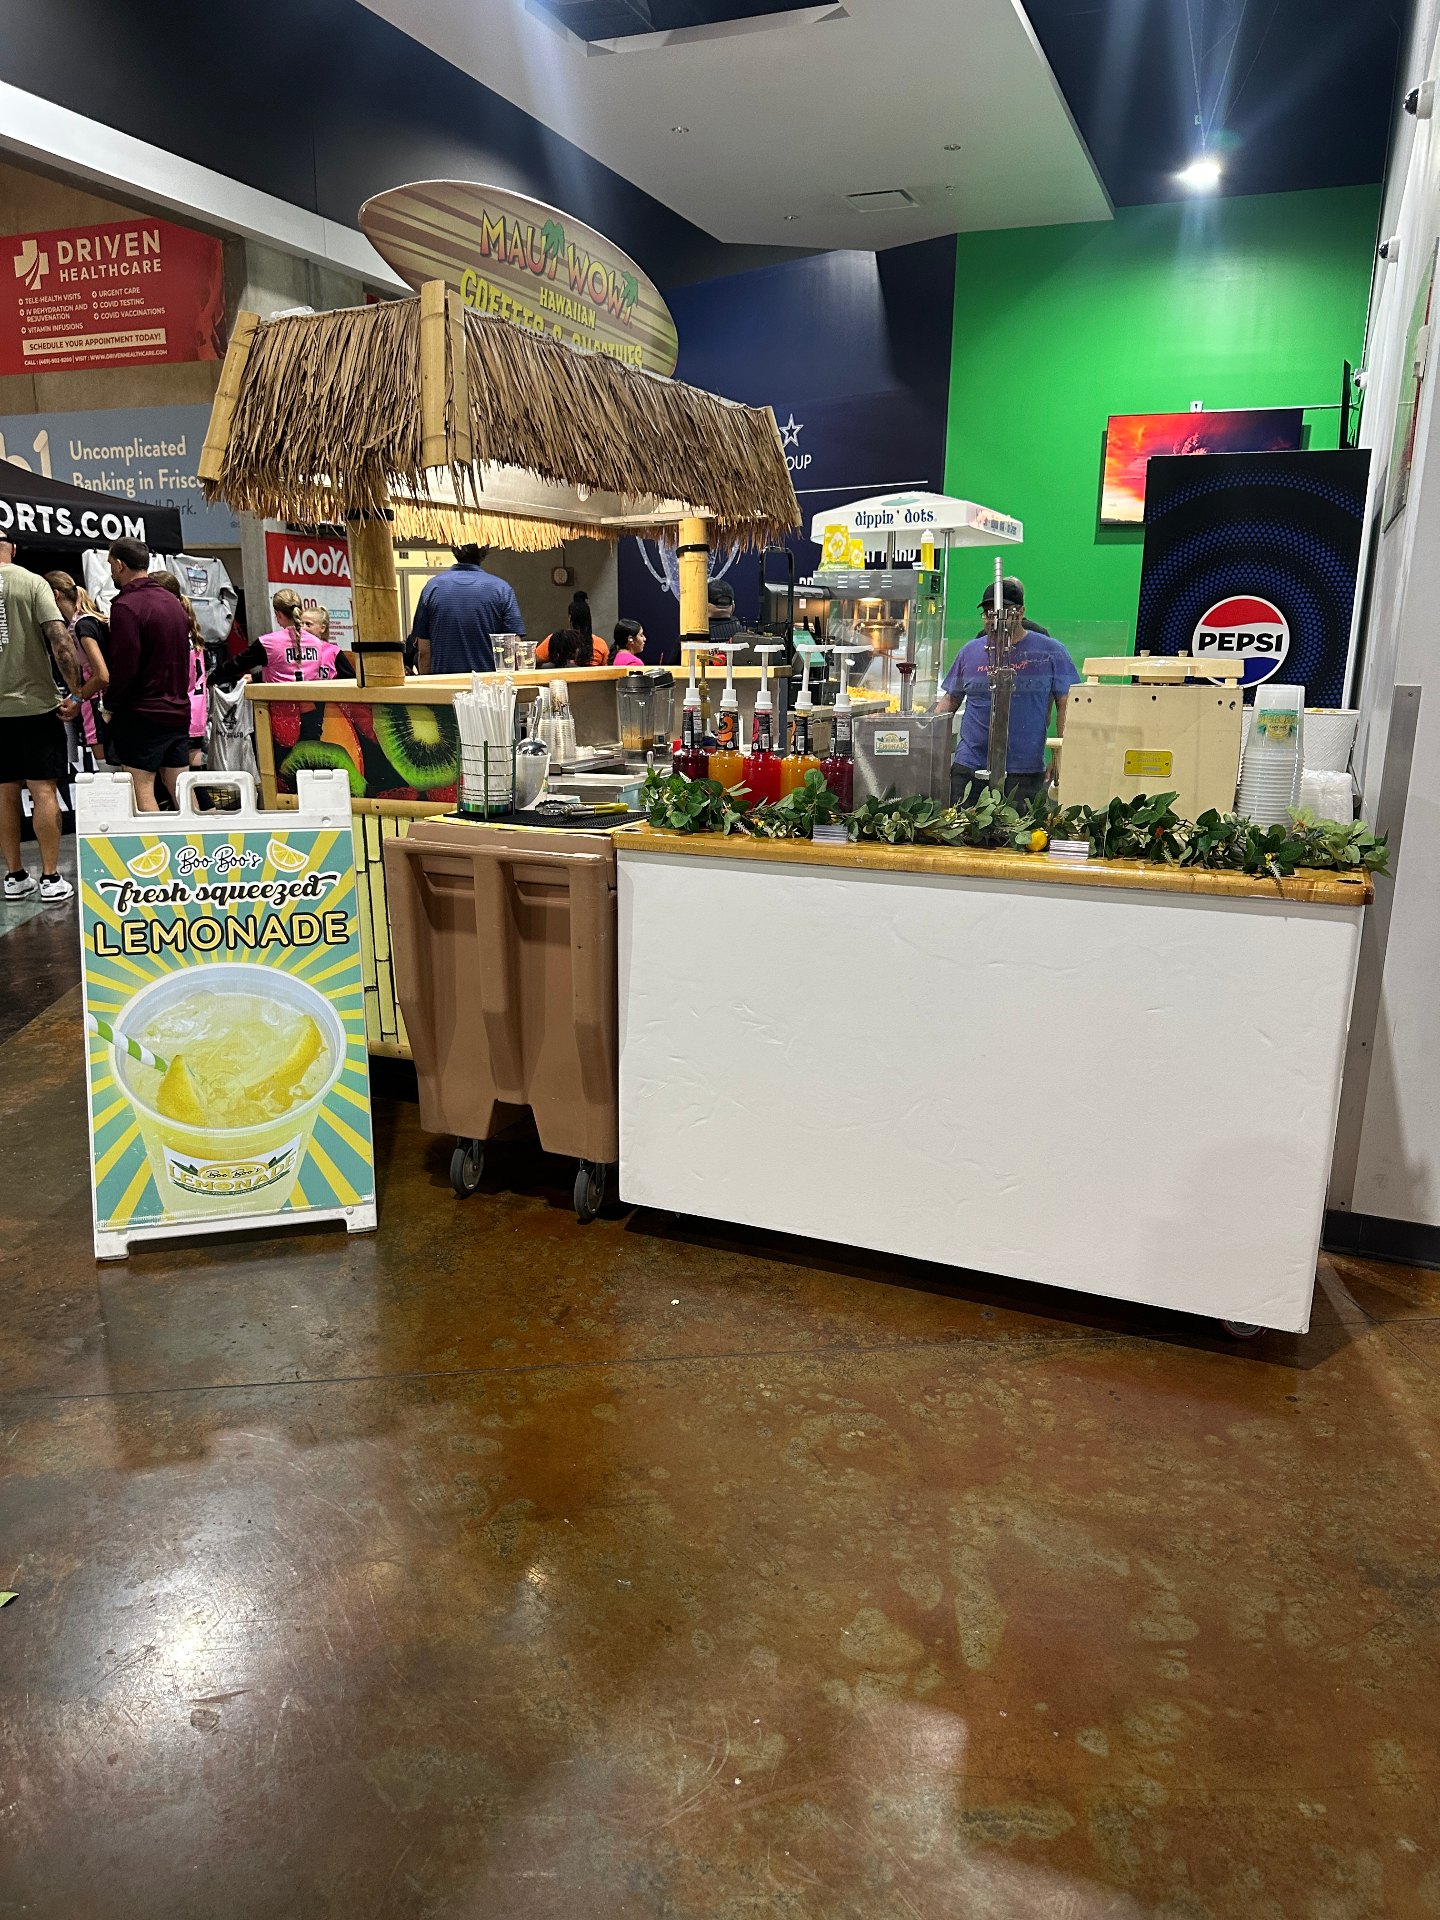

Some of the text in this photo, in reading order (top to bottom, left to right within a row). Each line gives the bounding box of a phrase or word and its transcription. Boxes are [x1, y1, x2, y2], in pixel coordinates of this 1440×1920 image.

[57, 229, 161, 265] DRIVEN
[60, 258, 162, 282] HEALTHCARE
[480, 209, 639, 325] MAUI WOWI
[25, 292, 82, 305] TELE-HEALTH VISITS
[98, 287, 141, 297] URGENT CARE
[32, 304, 74, 315] REHYDRATION
[75, 303, 88, 311] AND
[100, 298, 145, 309] COVID TESTING
[101, 307, 166, 320] COVID VACCINATIONS
[539, 286, 597, 330] HAWAIIAN
[26, 312, 71, 323] REJUVENATION
[28, 323, 84, 334] VITAMIN INFUSIONS
[29, 332, 162, 351] SCHEDULE YOUR APPOINTMENT TODAY!
[69, 434, 187, 466] Uncomplicated
[72, 470, 137, 499] Banking
[139, 471, 154, 491] in
[904, 508, 934, 524] dots
[1198, 632, 1284, 653] PEPSI
[177, 845, 263, 874] Boo Boo's
[99, 874, 339, 914] fresh squeezed
[94, 911, 351, 957] LEMONADE
[168, 1150, 297, 1191] LEMONADE
